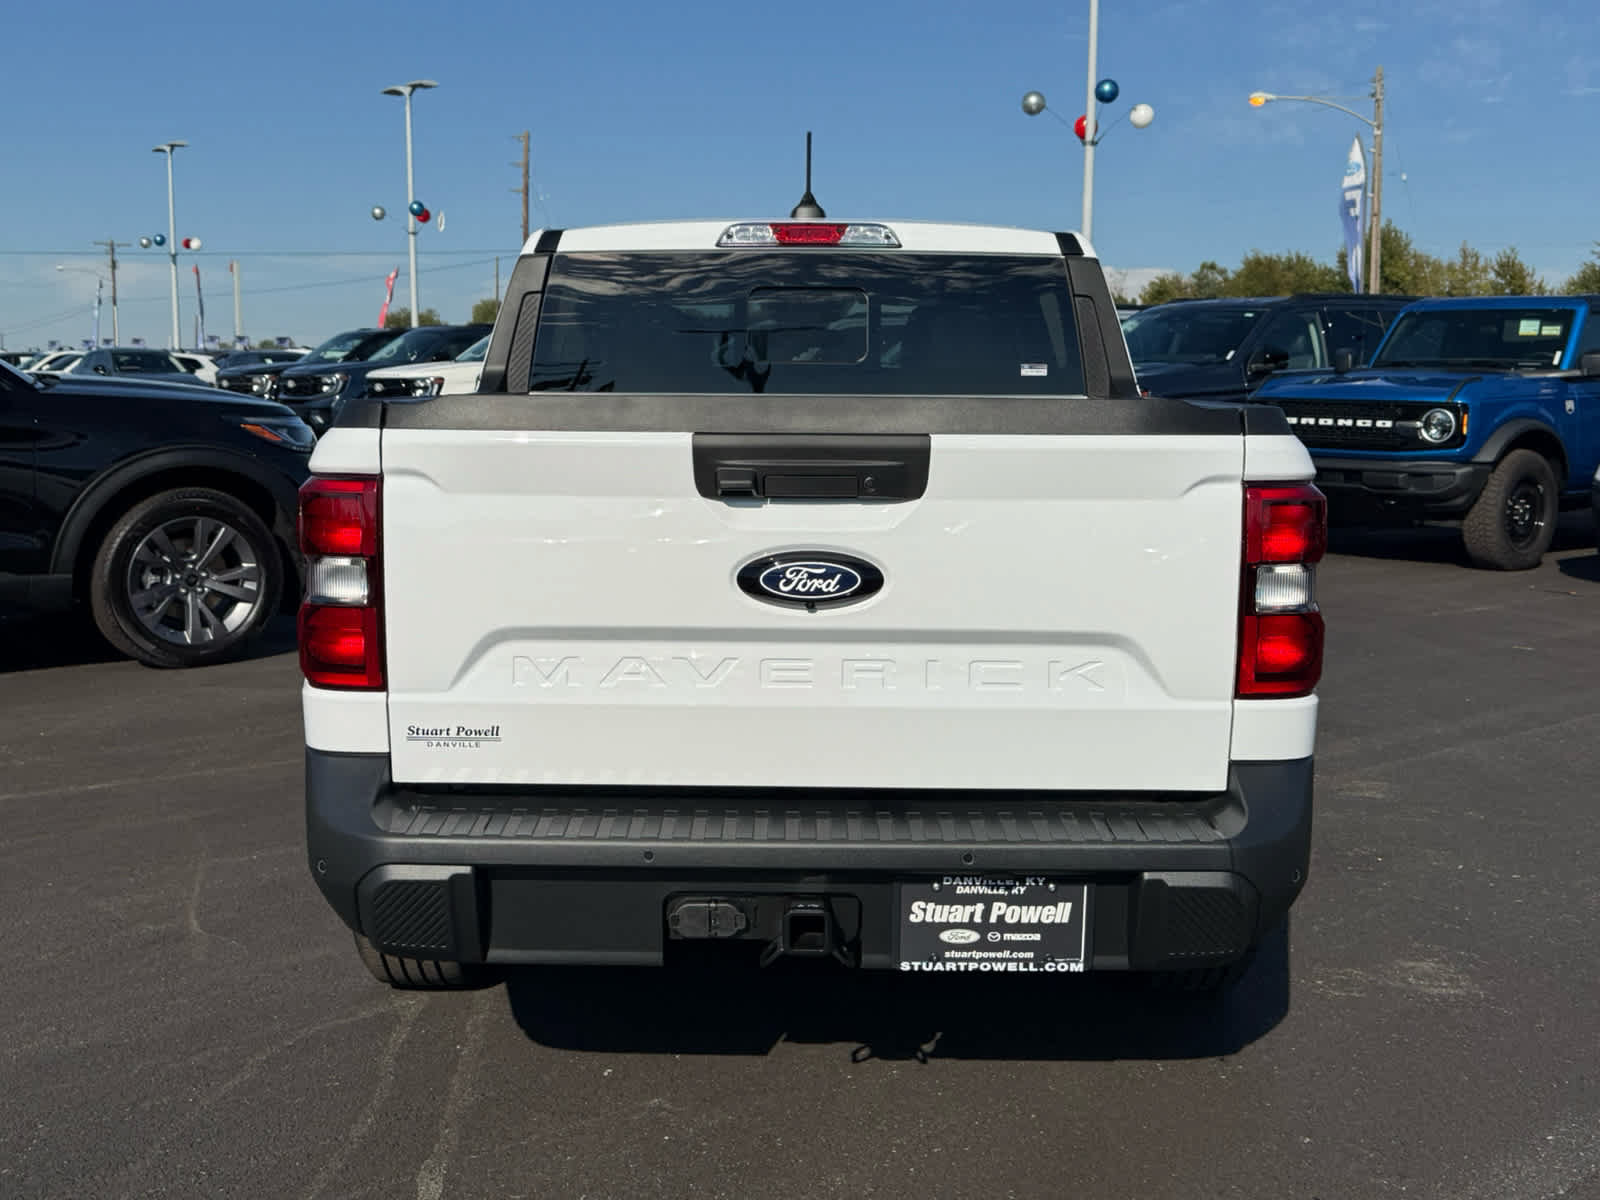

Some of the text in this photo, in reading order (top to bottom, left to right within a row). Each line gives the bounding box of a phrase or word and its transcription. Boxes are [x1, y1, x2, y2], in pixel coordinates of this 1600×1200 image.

[1286, 416, 1393, 428] BRONCO
[779, 566, 842, 592] Ford
[512, 655, 1105, 691] MAVERICK
[407, 725, 500, 737] Stuart Powell
[1025, 877, 1046, 886] KY
[956, 886, 1027, 896] DANVILLE, KY
[909, 901, 1073, 924] Stuart Powell
[944, 950, 1034, 959] stuartpowell.com
[900, 961, 1084, 972] STUARTPOWELL.COM
